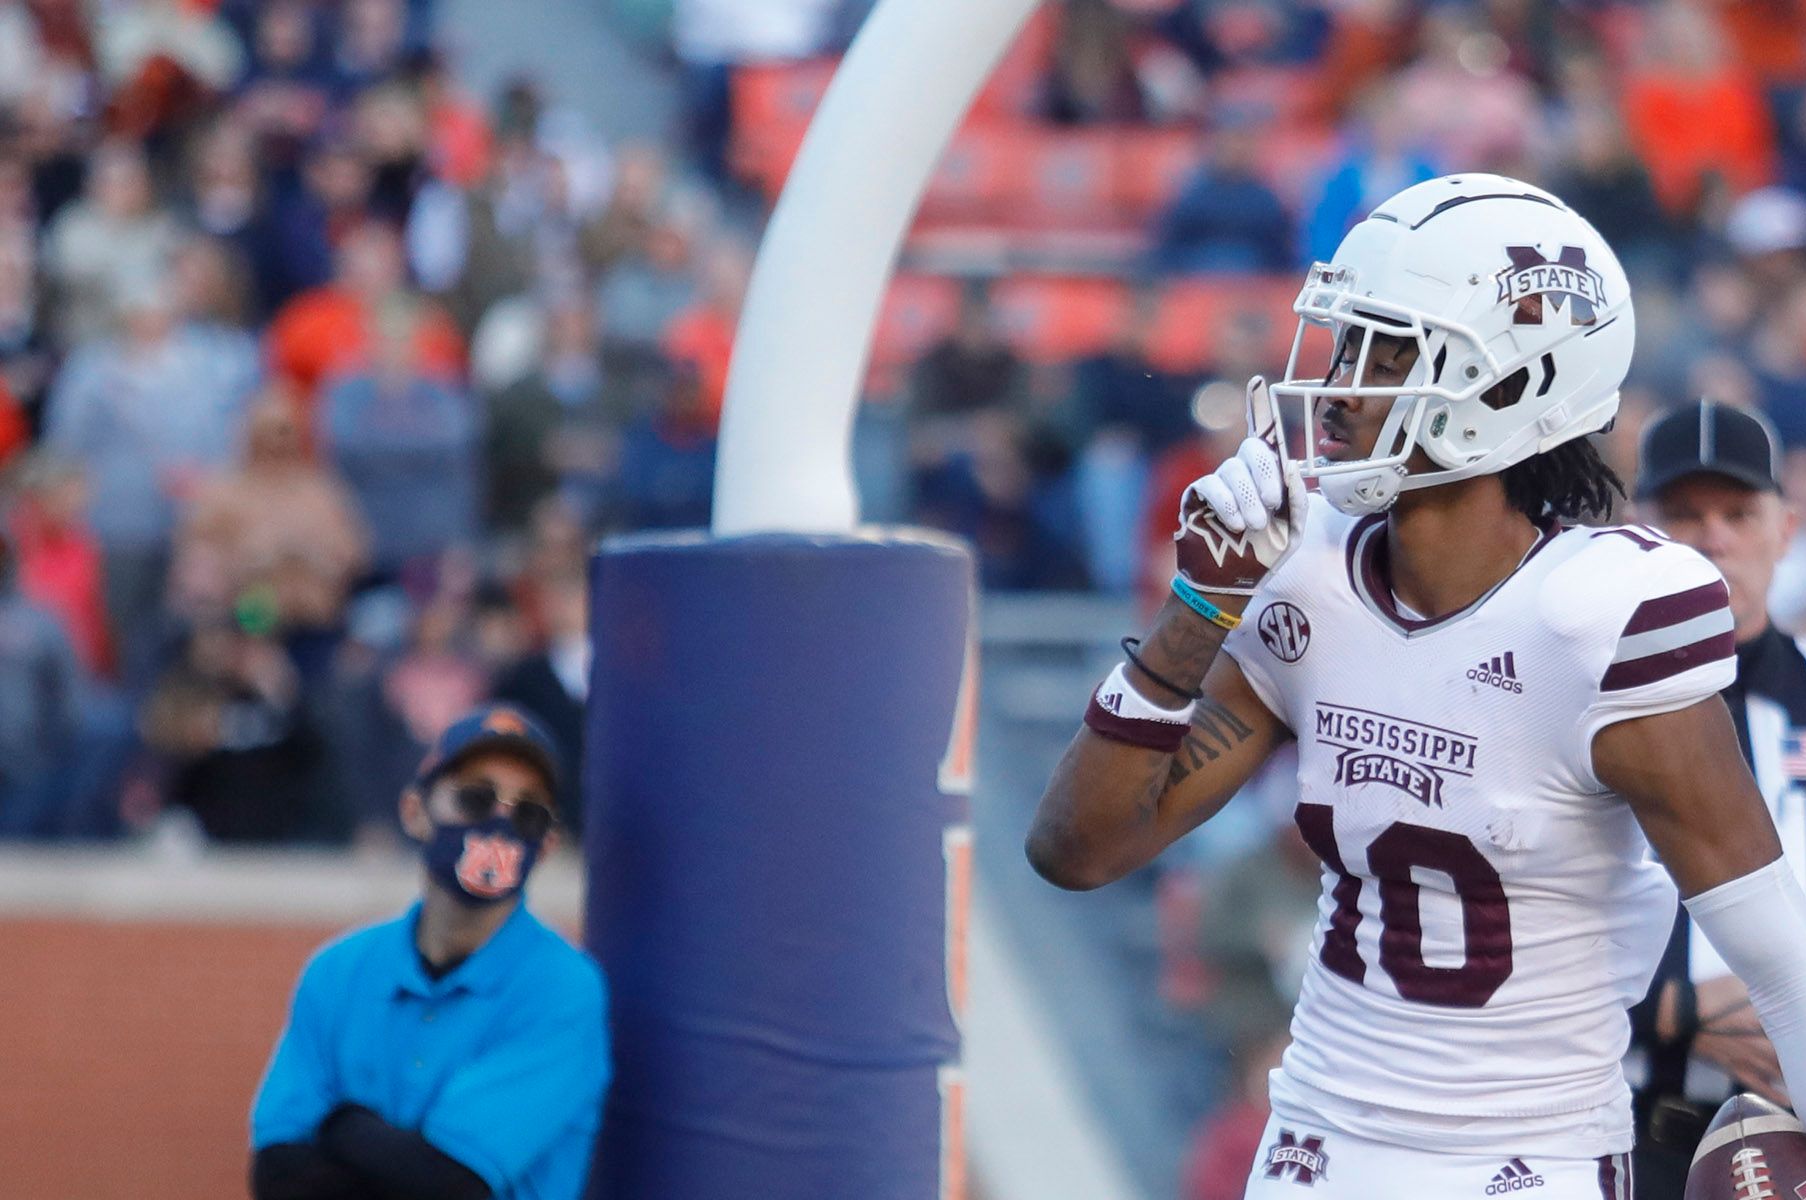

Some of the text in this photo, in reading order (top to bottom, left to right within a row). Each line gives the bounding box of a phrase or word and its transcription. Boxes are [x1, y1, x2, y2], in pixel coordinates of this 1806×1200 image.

[1518, 268, 1590, 297] STATE
[1259, 602, 1311, 663] SEC
[1466, 665, 1523, 694] adidas
[1315, 708, 1478, 770] MISSISSIPPI
[1351, 758, 1426, 799] STATE
[1293, 803, 1514, 1010] 10
[1276, 1148, 1315, 1168] STATE
[1484, 1175, 1545, 1196] adidas
